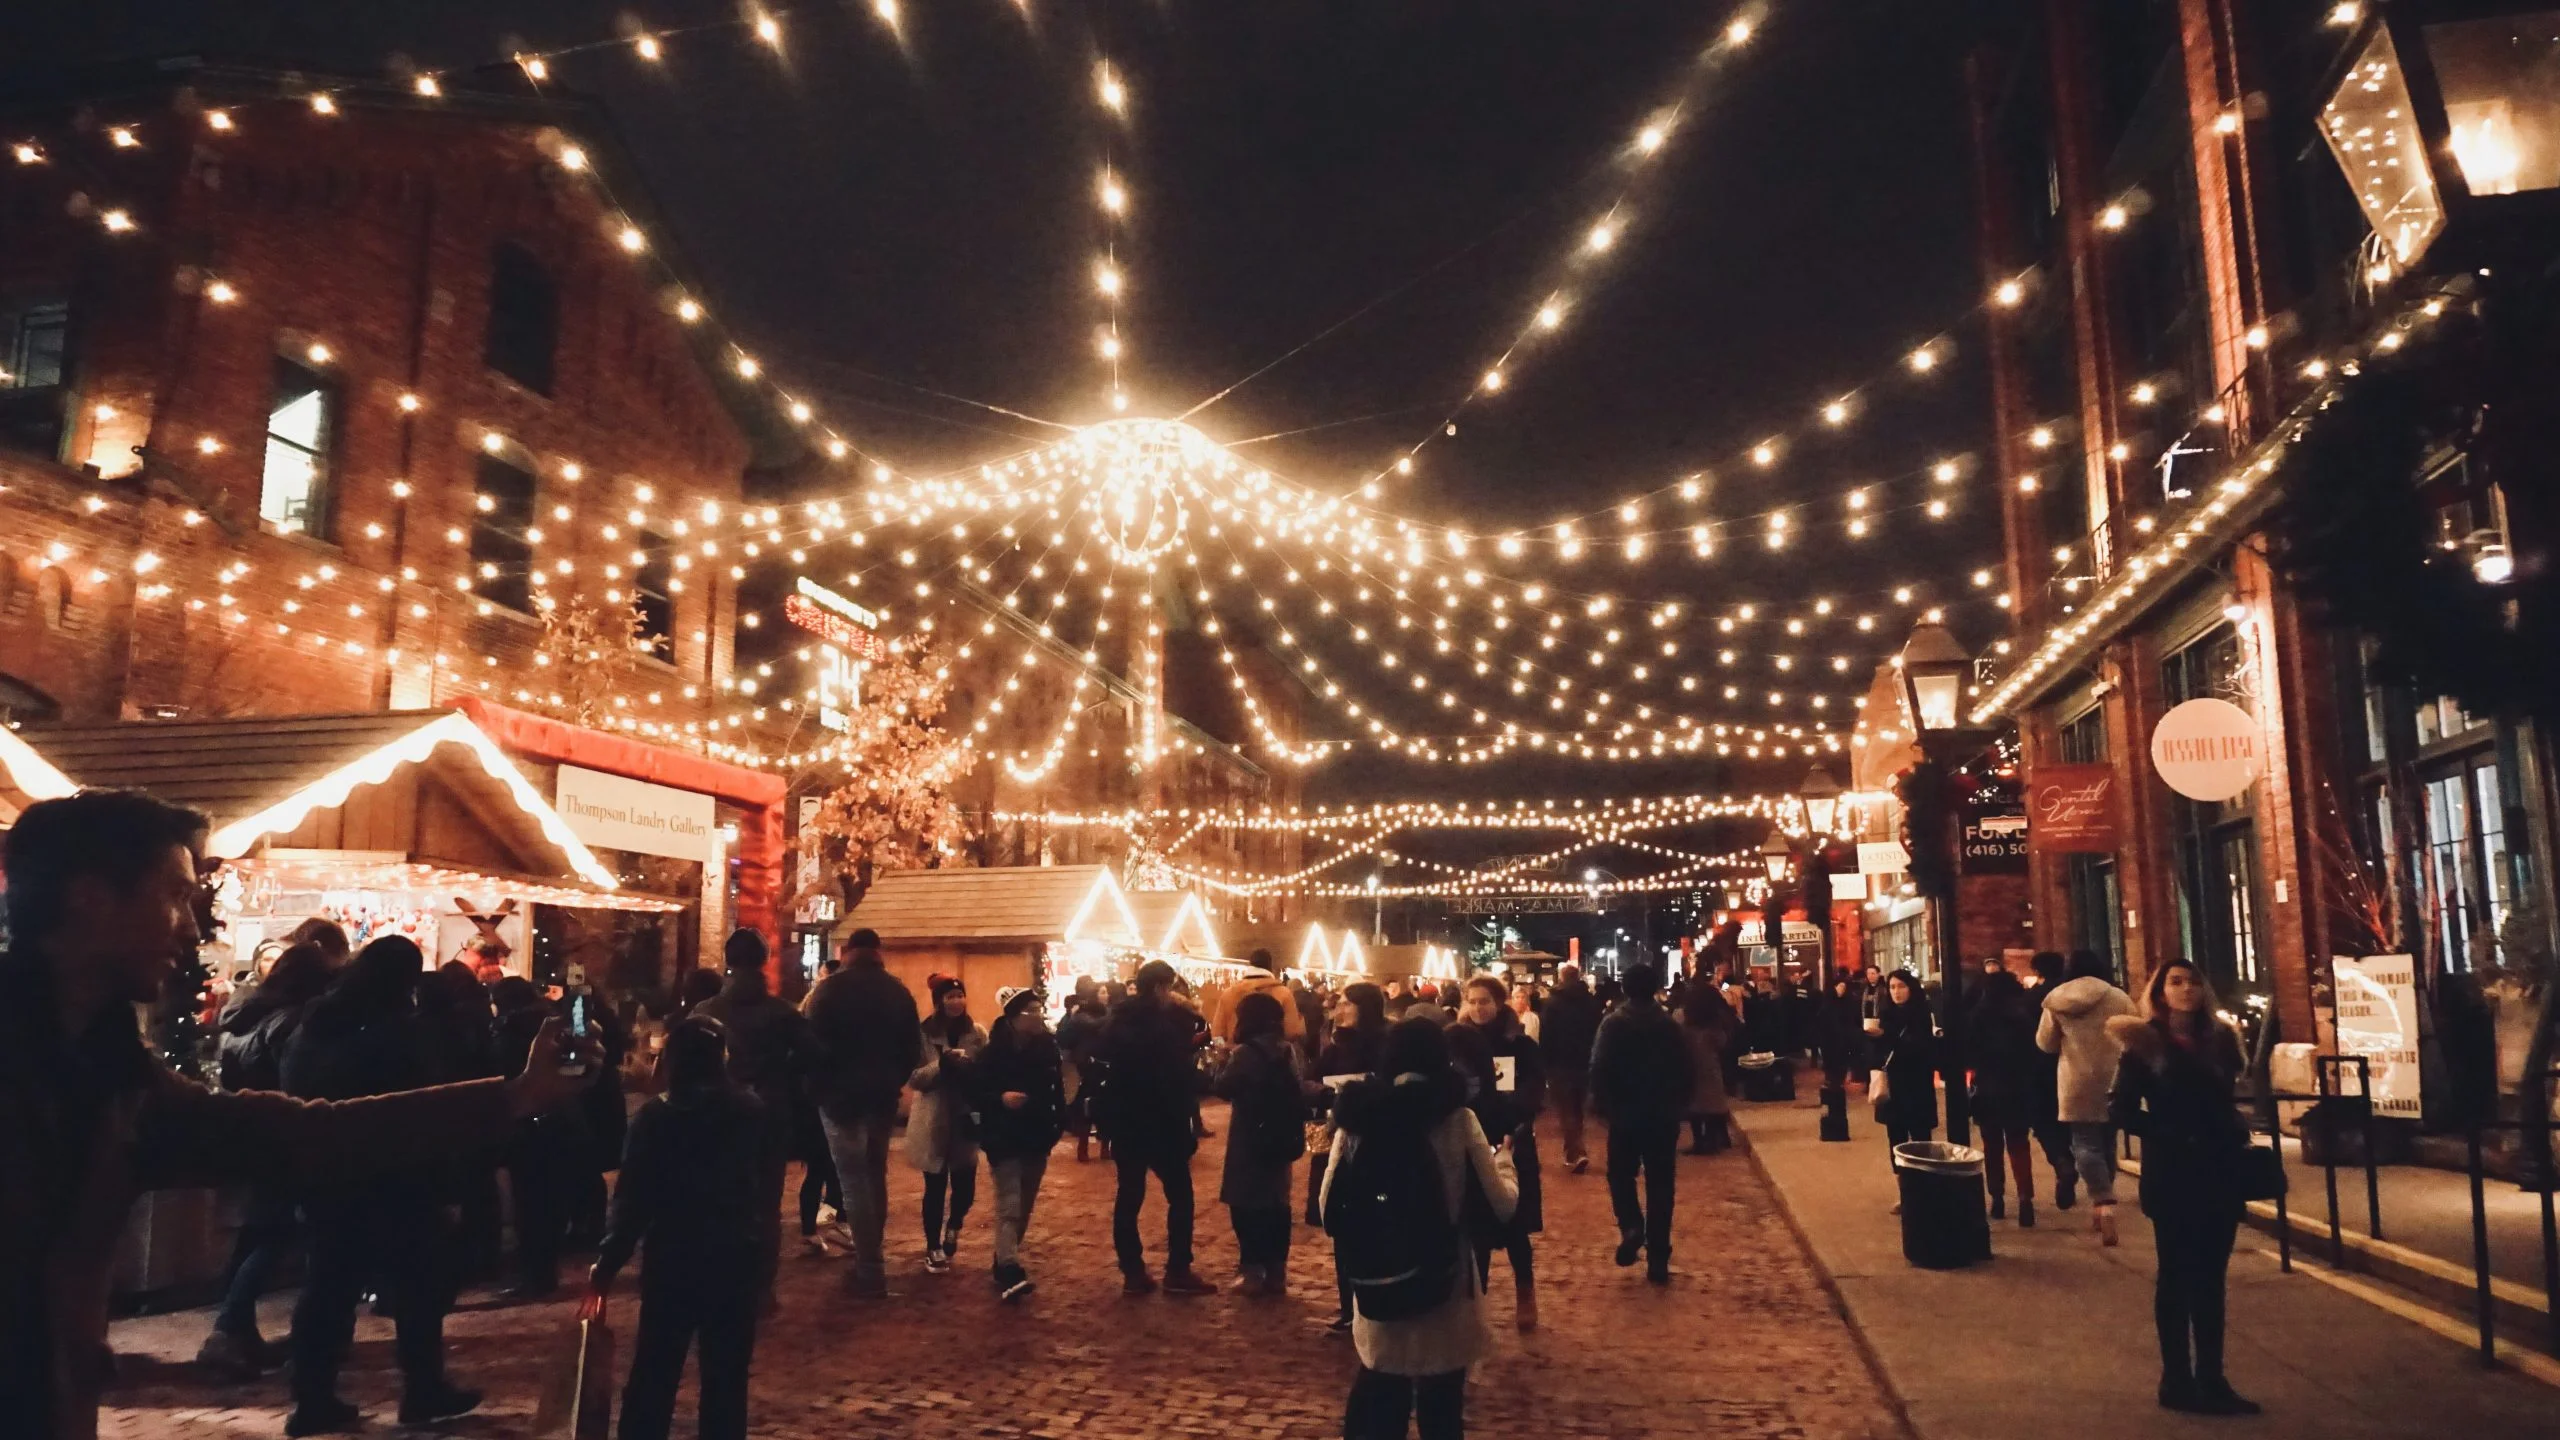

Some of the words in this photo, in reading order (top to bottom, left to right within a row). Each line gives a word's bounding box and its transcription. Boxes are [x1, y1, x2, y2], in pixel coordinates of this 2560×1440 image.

[820, 643, 861, 710] 24
[564, 794, 627, 824] Thompson
[631, 806, 666, 834] Landry
[670, 815, 707, 842] Gallery
[1966, 844, 2005, 858] (416)
